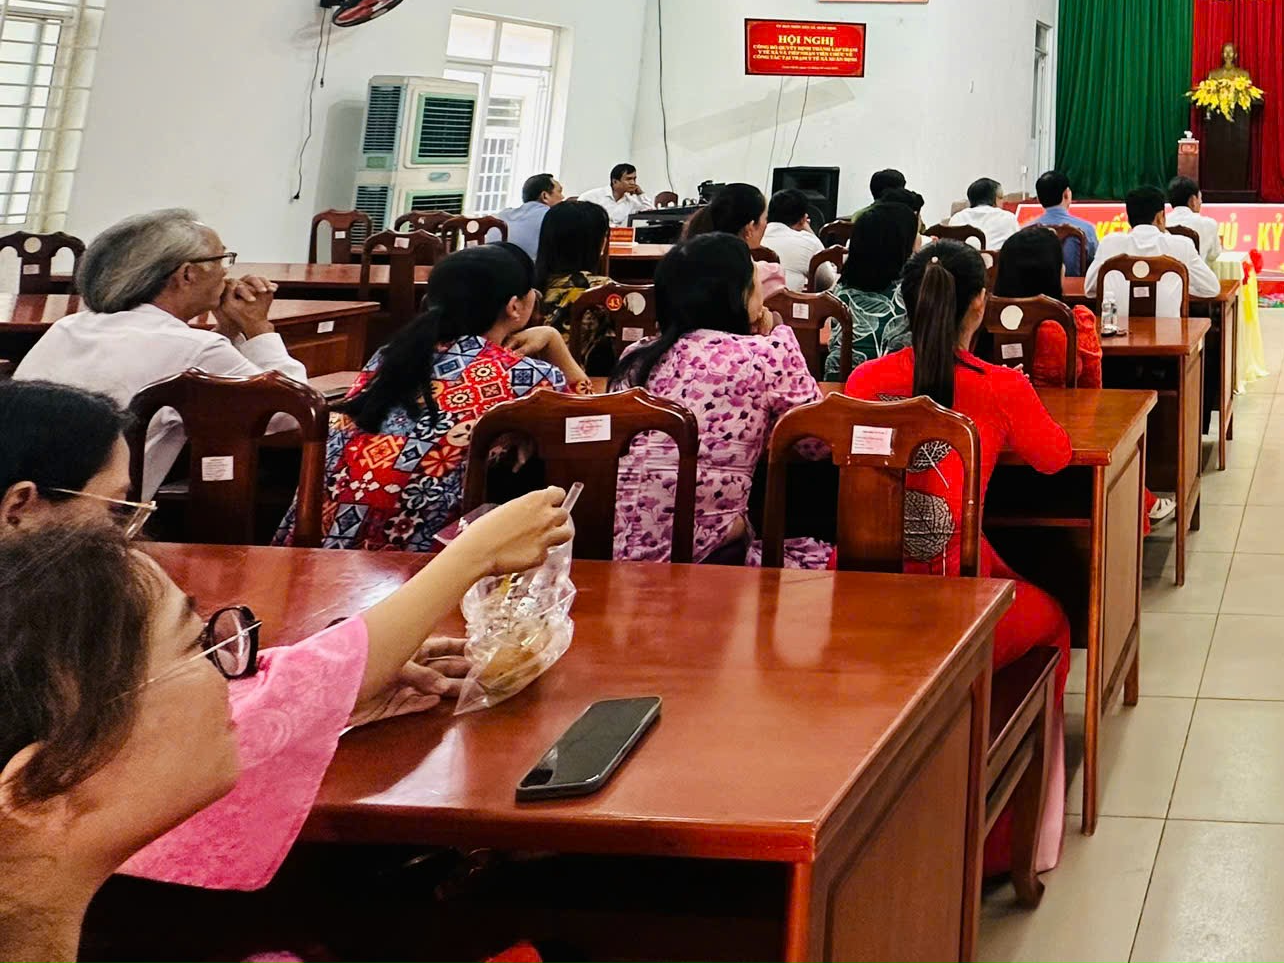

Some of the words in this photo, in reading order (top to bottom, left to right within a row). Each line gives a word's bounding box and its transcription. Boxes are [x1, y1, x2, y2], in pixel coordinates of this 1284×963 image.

[778, 34, 801, 46] HỘI
[803, 36, 834, 47] NGHỊ
[1256, 213, 1284, 251] KỶ
